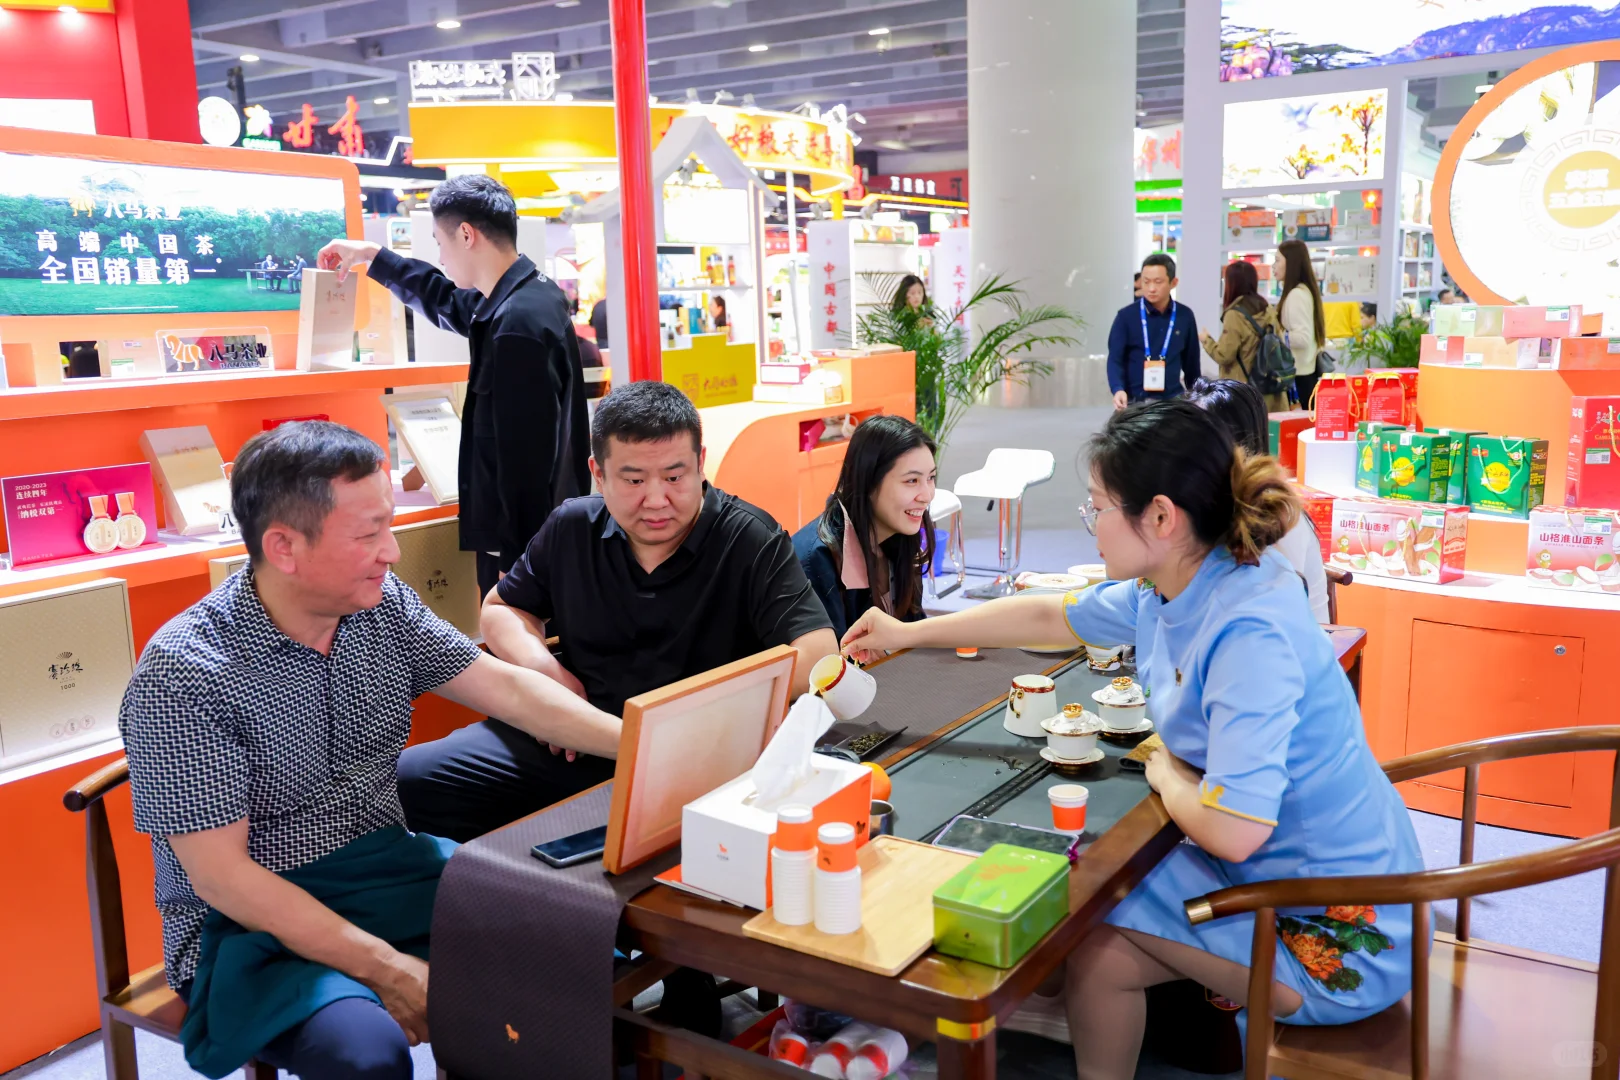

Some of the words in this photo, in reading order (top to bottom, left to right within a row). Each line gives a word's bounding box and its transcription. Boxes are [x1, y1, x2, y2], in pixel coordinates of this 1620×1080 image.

[35, 229, 214, 256] 高端中国茶
[208, 343, 269, 362] 八马茶业
[15, 482, 47, 491] 2020-2023
[16, 489, 48, 500] 连续四年
[1340, 519, 1390, 533] 山格淮山面条
[1539, 532, 1605, 546] 山格淮山面条
[61, 682, 76, 690] 1000
